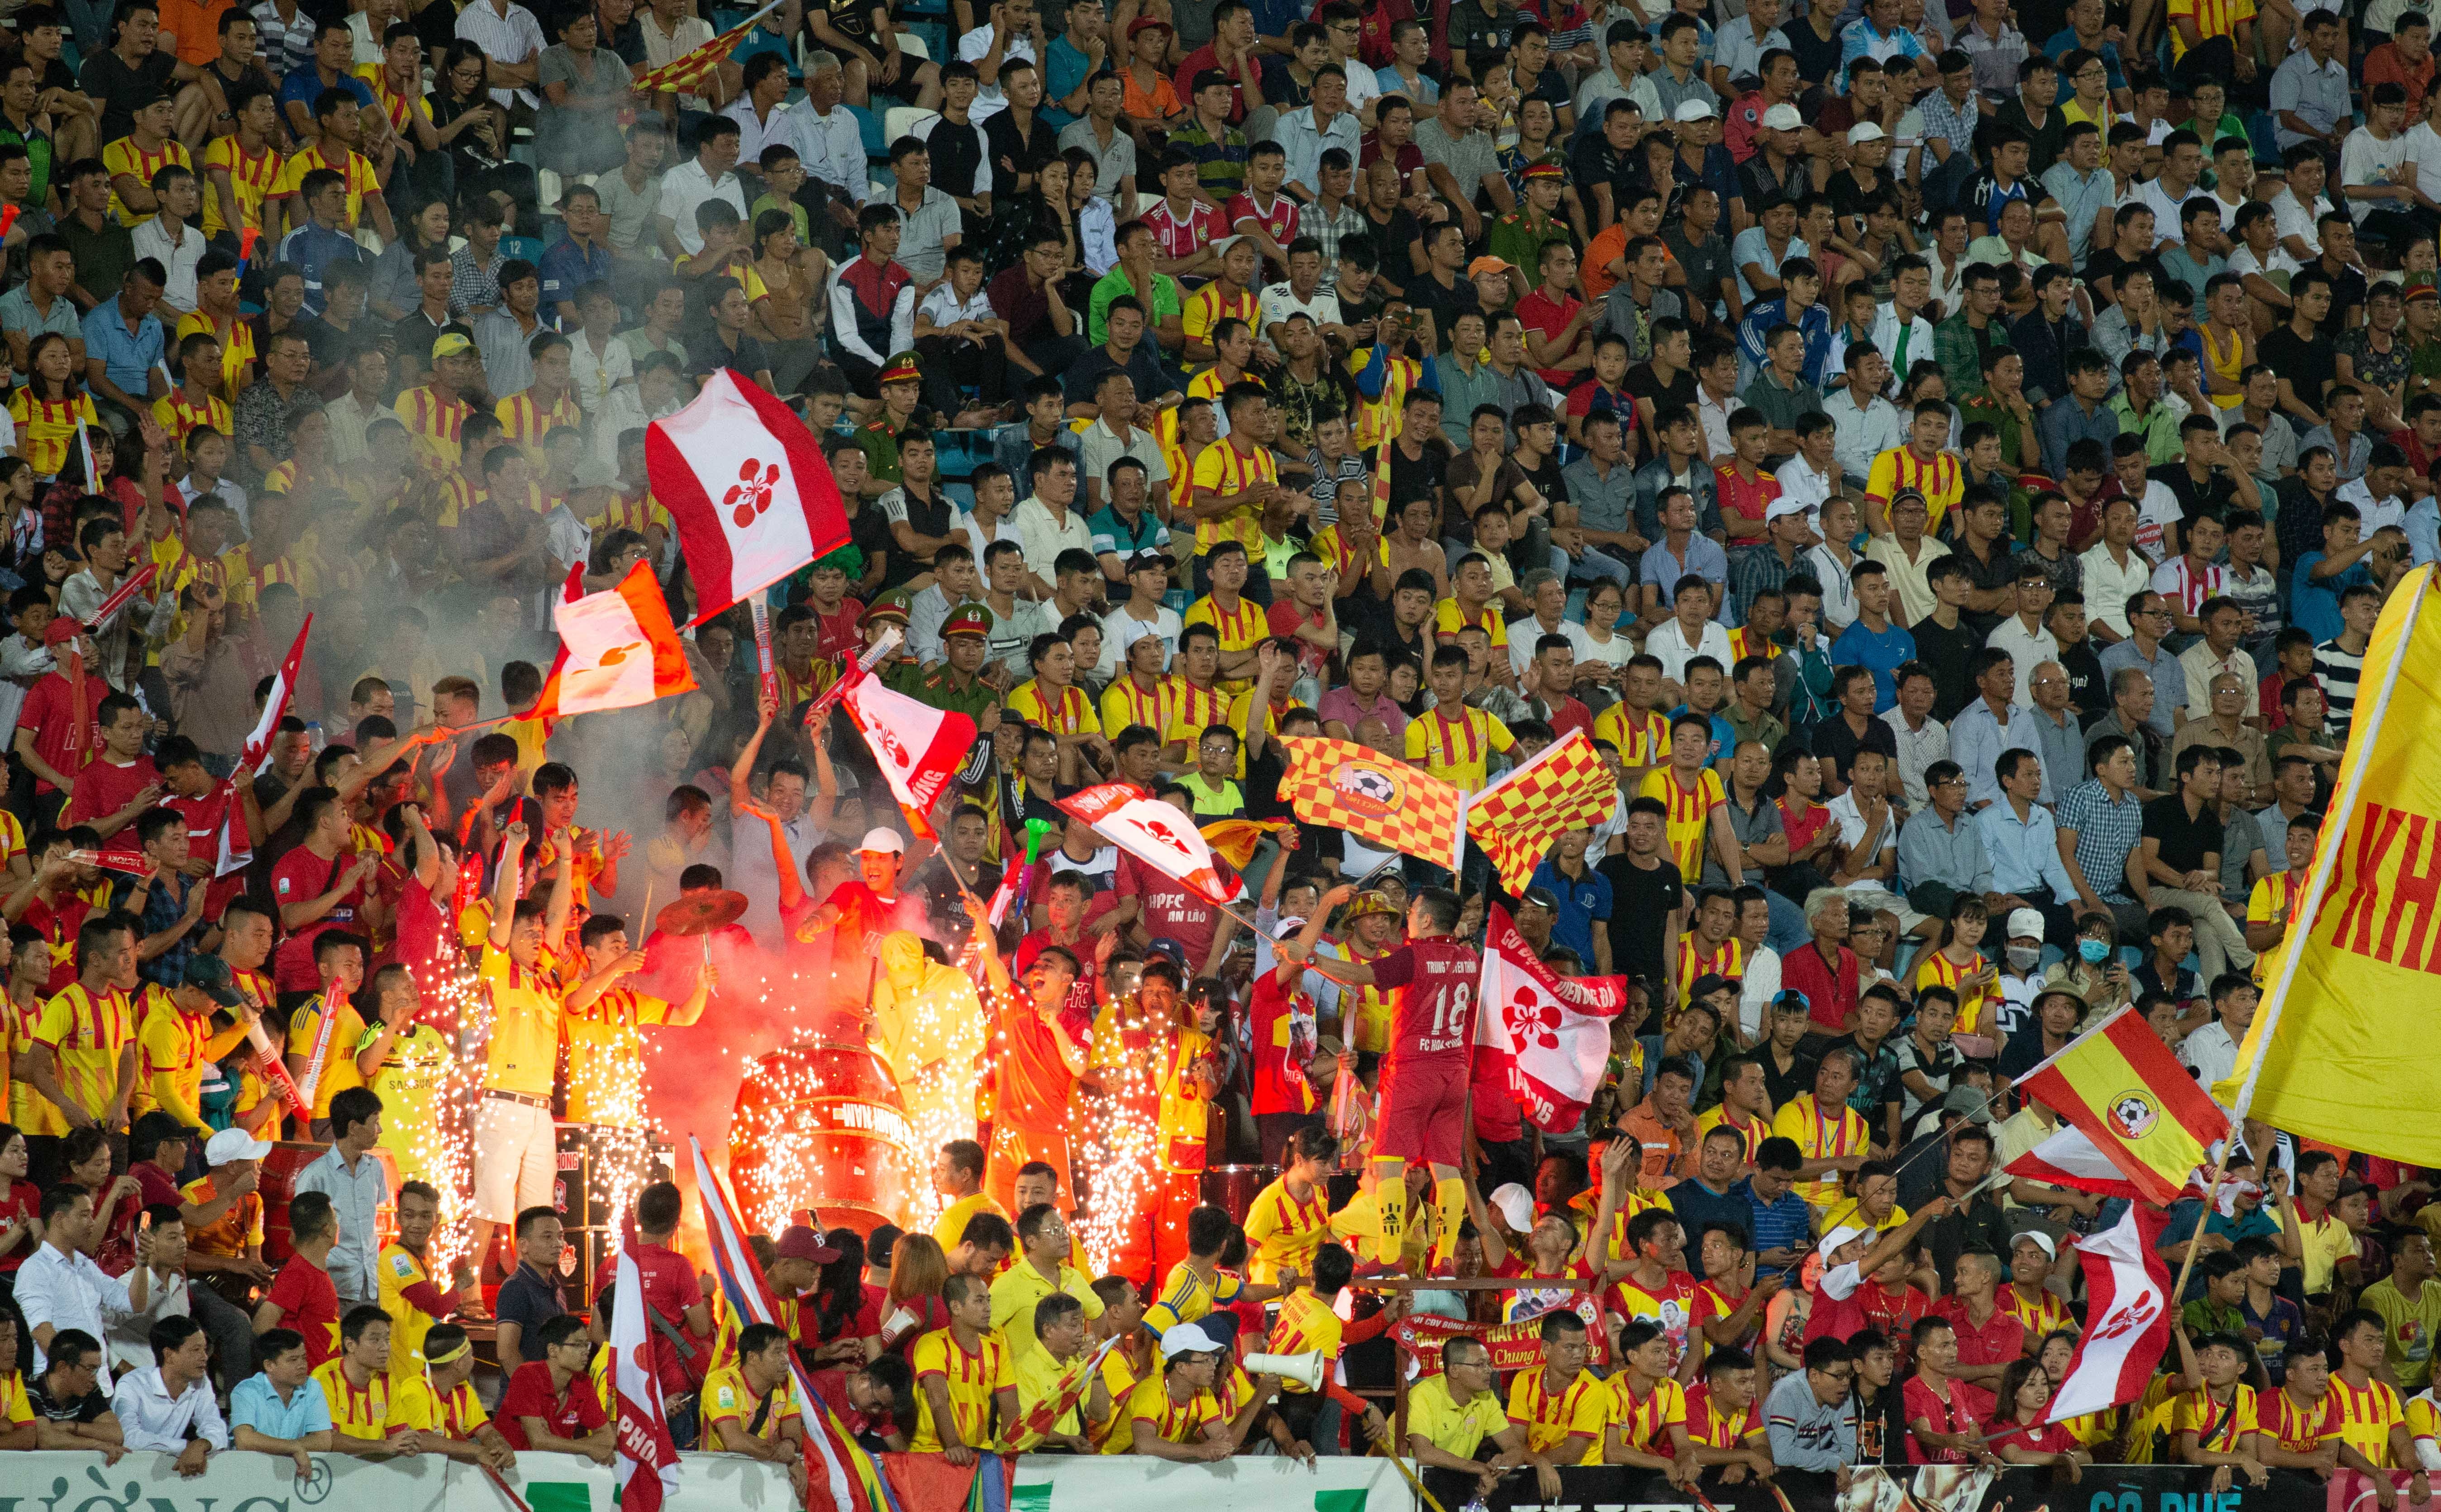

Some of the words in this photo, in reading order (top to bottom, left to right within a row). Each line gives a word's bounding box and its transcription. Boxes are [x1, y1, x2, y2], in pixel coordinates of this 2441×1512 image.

[509, 240, 521, 254] 12
[1149, 892, 1185, 909] HPFC
[1168, 910, 1184, 922] AN
[1431, 982, 1470, 1036] 18
[1419, 1038, 1430, 1052] FC
[813, 1233, 825, 1248] B
[1494, 1349, 1535, 1365] Chung
